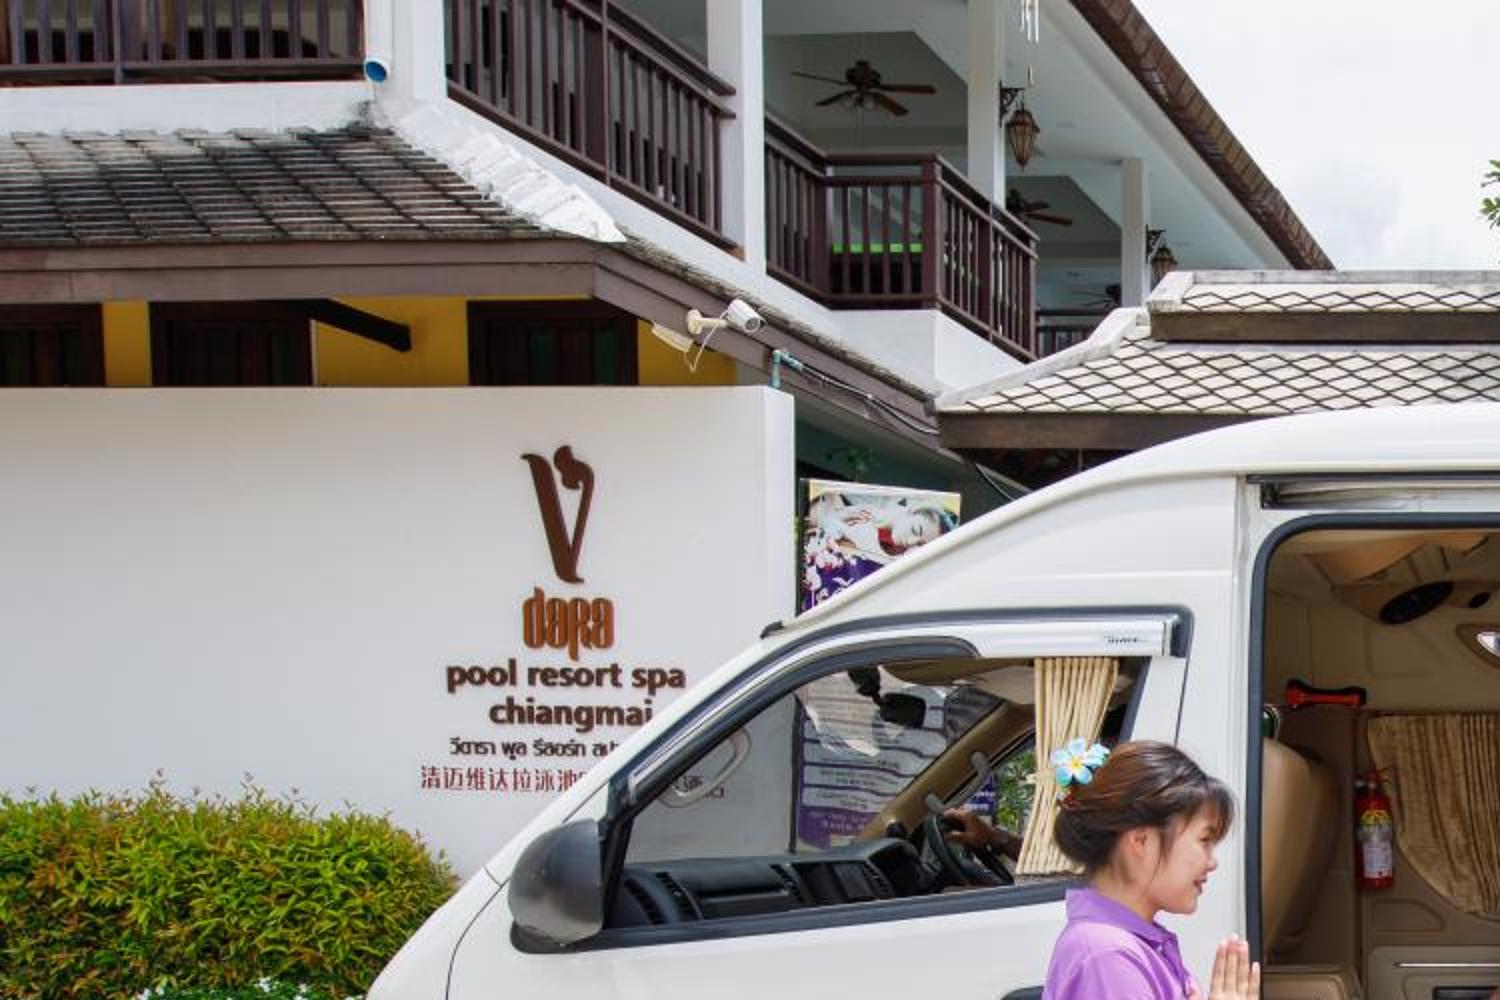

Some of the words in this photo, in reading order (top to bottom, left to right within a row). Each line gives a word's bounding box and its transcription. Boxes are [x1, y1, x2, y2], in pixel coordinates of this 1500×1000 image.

[446, 658, 517, 694] pool
[527, 663, 623, 689] resort
[631, 666, 687, 696] spa
[488, 696, 654, 733] chiangmai
